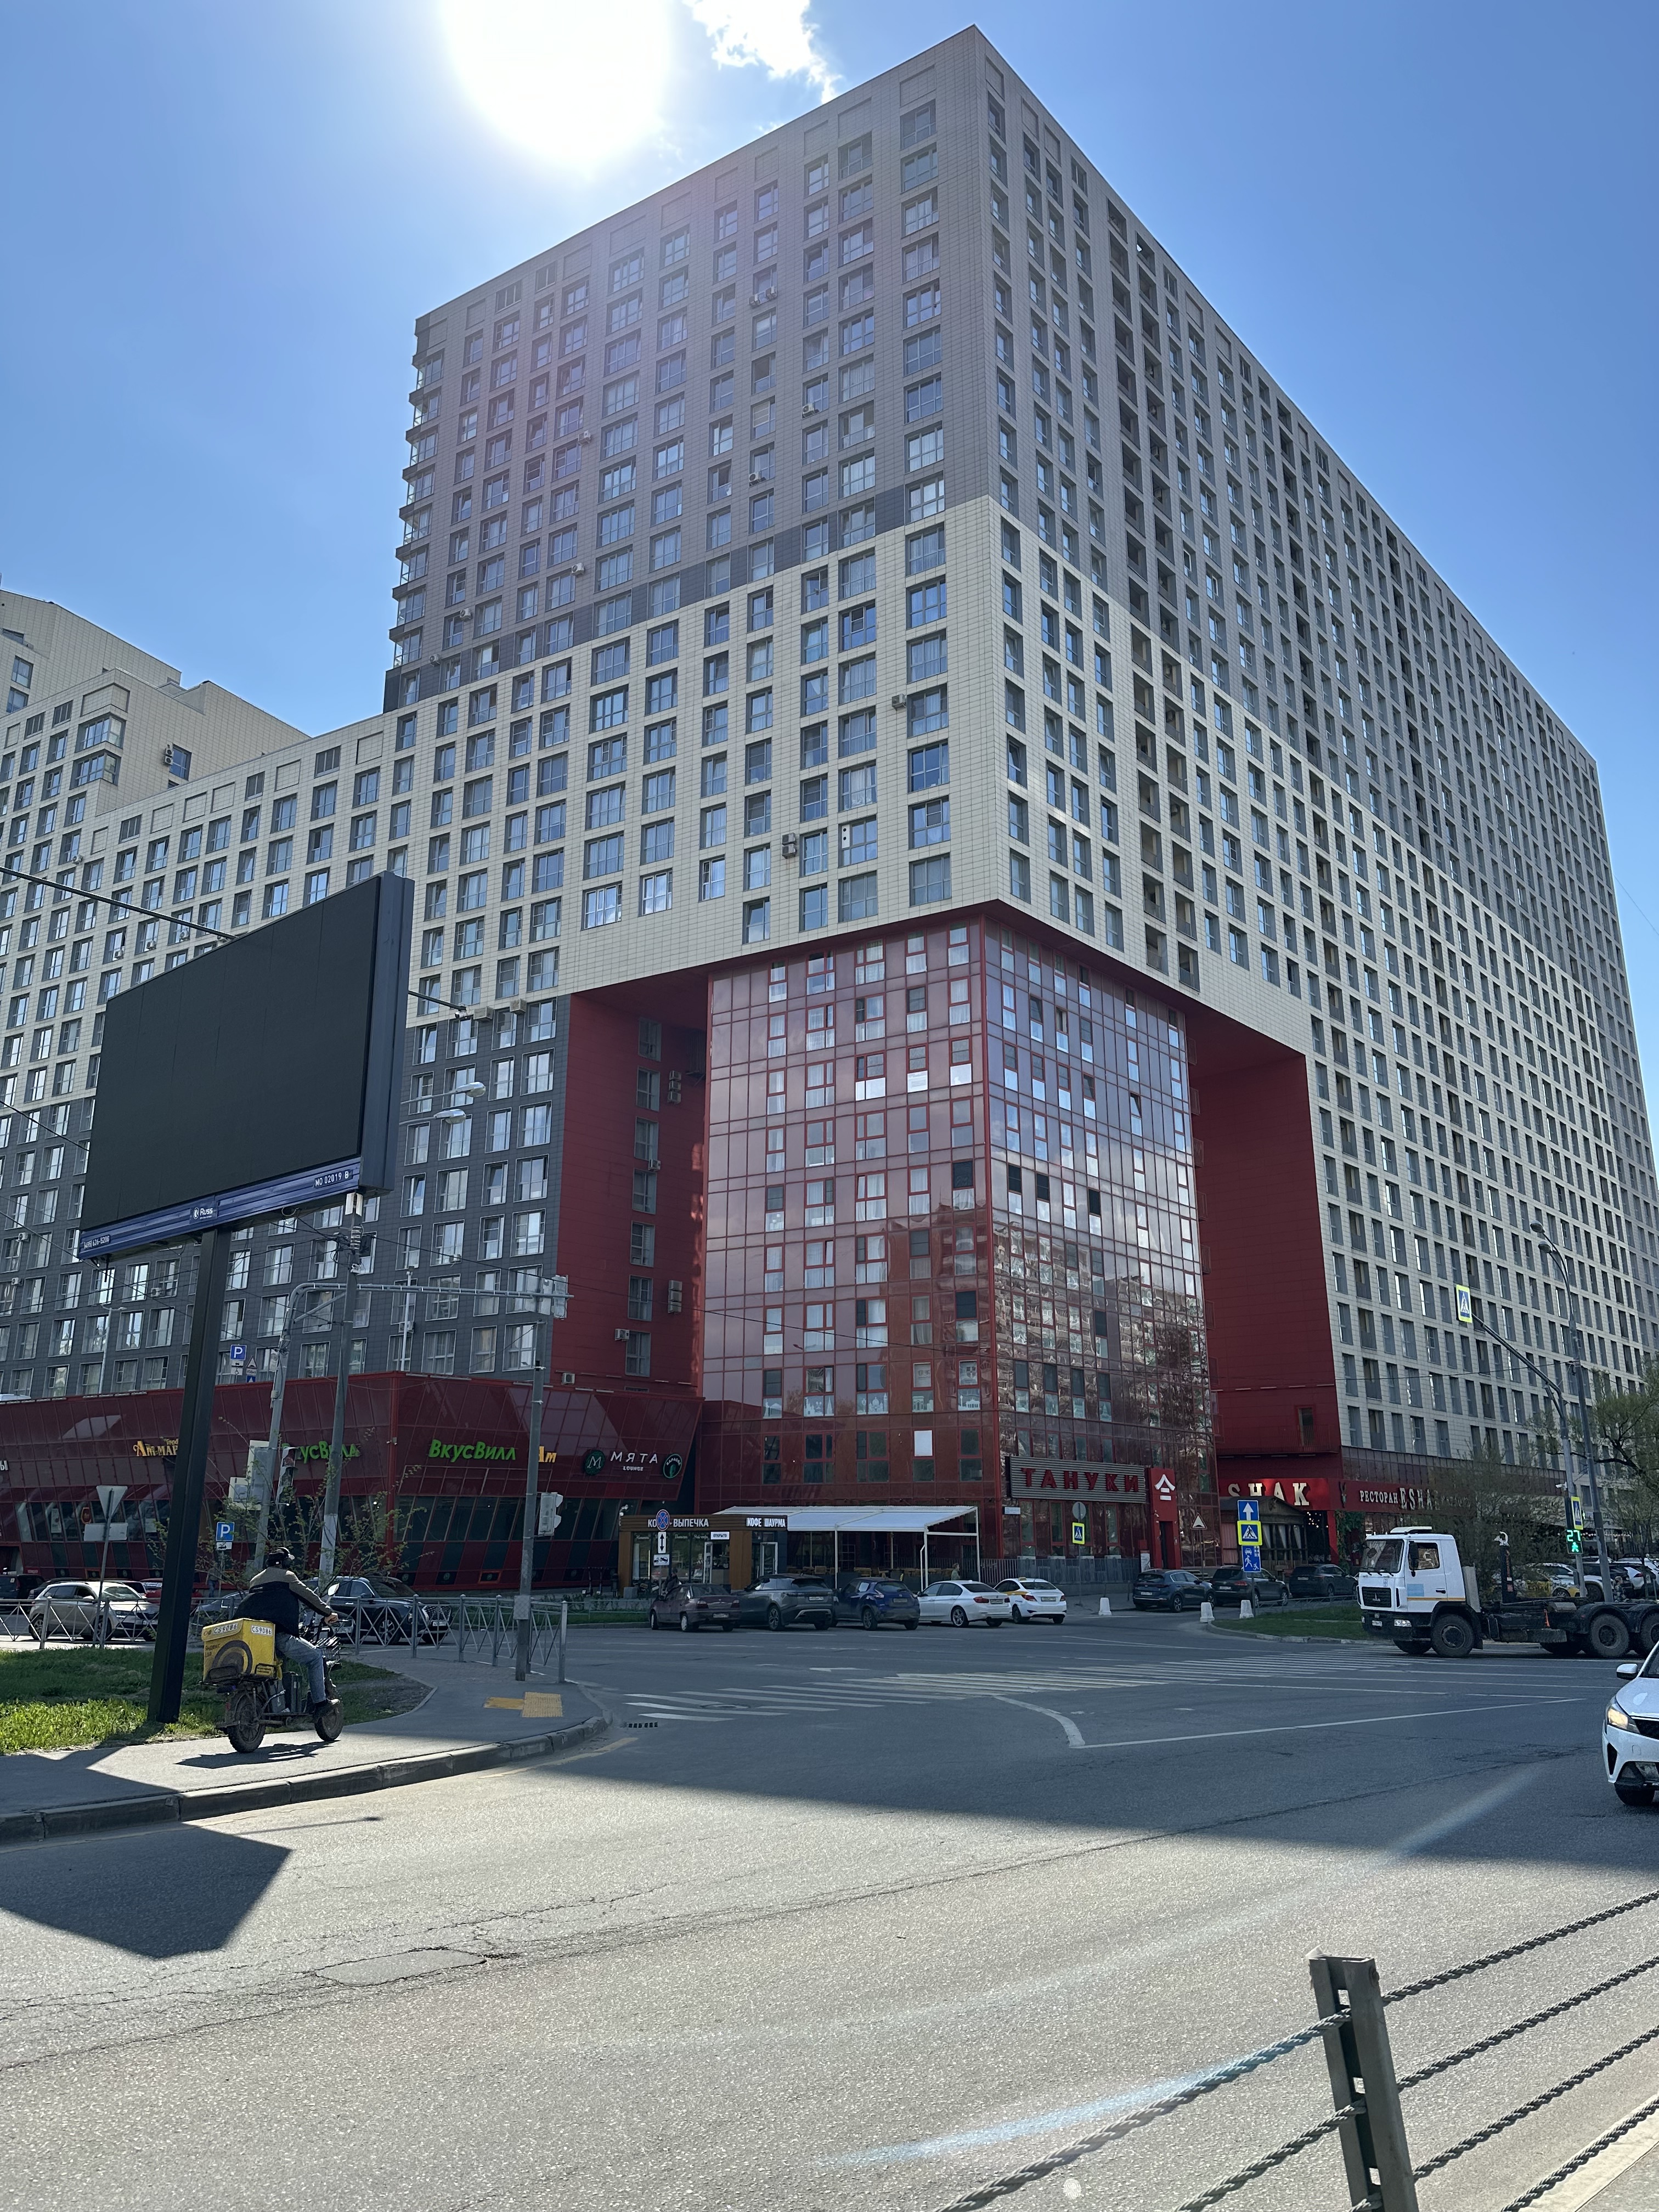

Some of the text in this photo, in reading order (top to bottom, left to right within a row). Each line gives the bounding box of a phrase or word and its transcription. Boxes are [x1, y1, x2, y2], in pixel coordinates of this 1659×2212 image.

[324, 1172, 342, 1183] 02019
[234, 1346, 243, 1358] P
[428, 1440, 516, 1463] ВкусВилл
[610, 1451, 658, 1464] МЯТА
[1020, 1467, 1139, 1492] ТАНУКИ
[1360, 1490, 1398, 1504] РЕСТОРАН
[673, 1519, 709, 1527] ВЫПЕЧКА
[747, 1517, 786, 1527] КОФЕ ШАУРМА
[221, 1524, 230, 1538] P
[1566, 1530, 1581, 1542] 27
[214, 1624, 237, 1634] CS9086
[252, 1626, 272, 1635] CS9086
